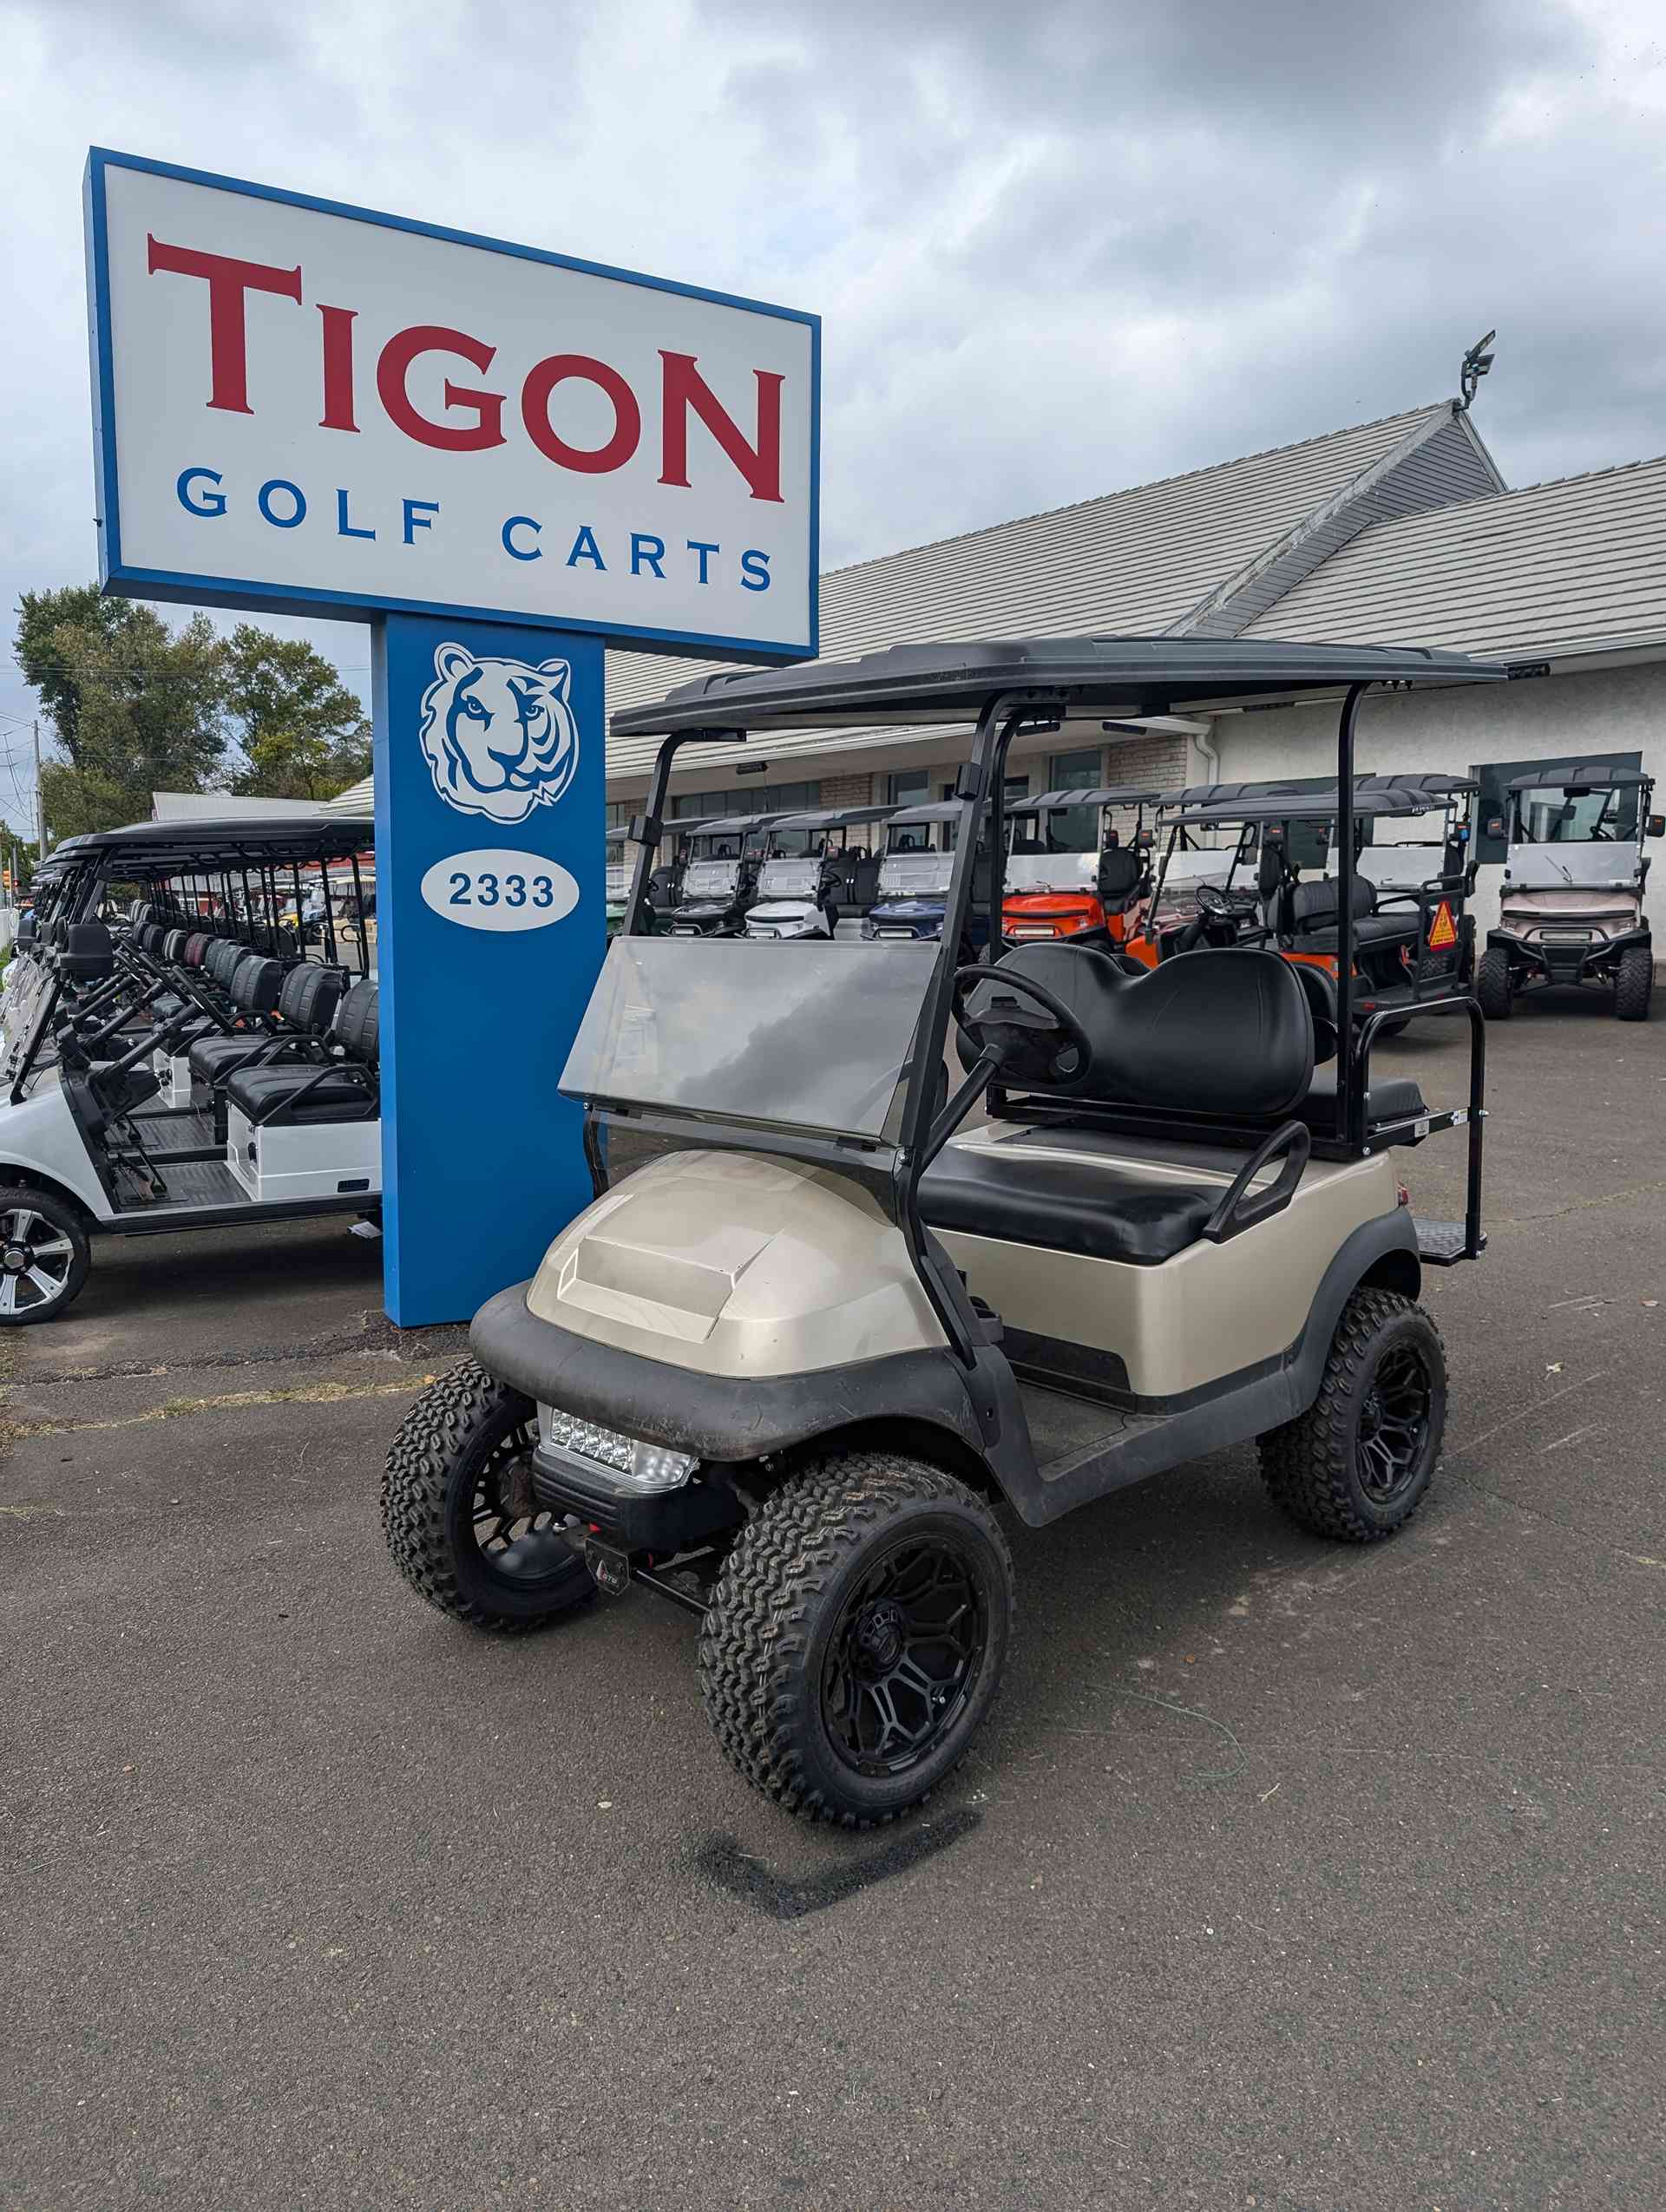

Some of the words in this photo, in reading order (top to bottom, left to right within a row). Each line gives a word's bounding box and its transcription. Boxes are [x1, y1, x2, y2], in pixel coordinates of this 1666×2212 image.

[147, 232, 785, 503] TIGON
[176, 467, 440, 545] GOLF
[502, 515, 771, 592] CARTS
[449, 873, 554, 907] 2333
